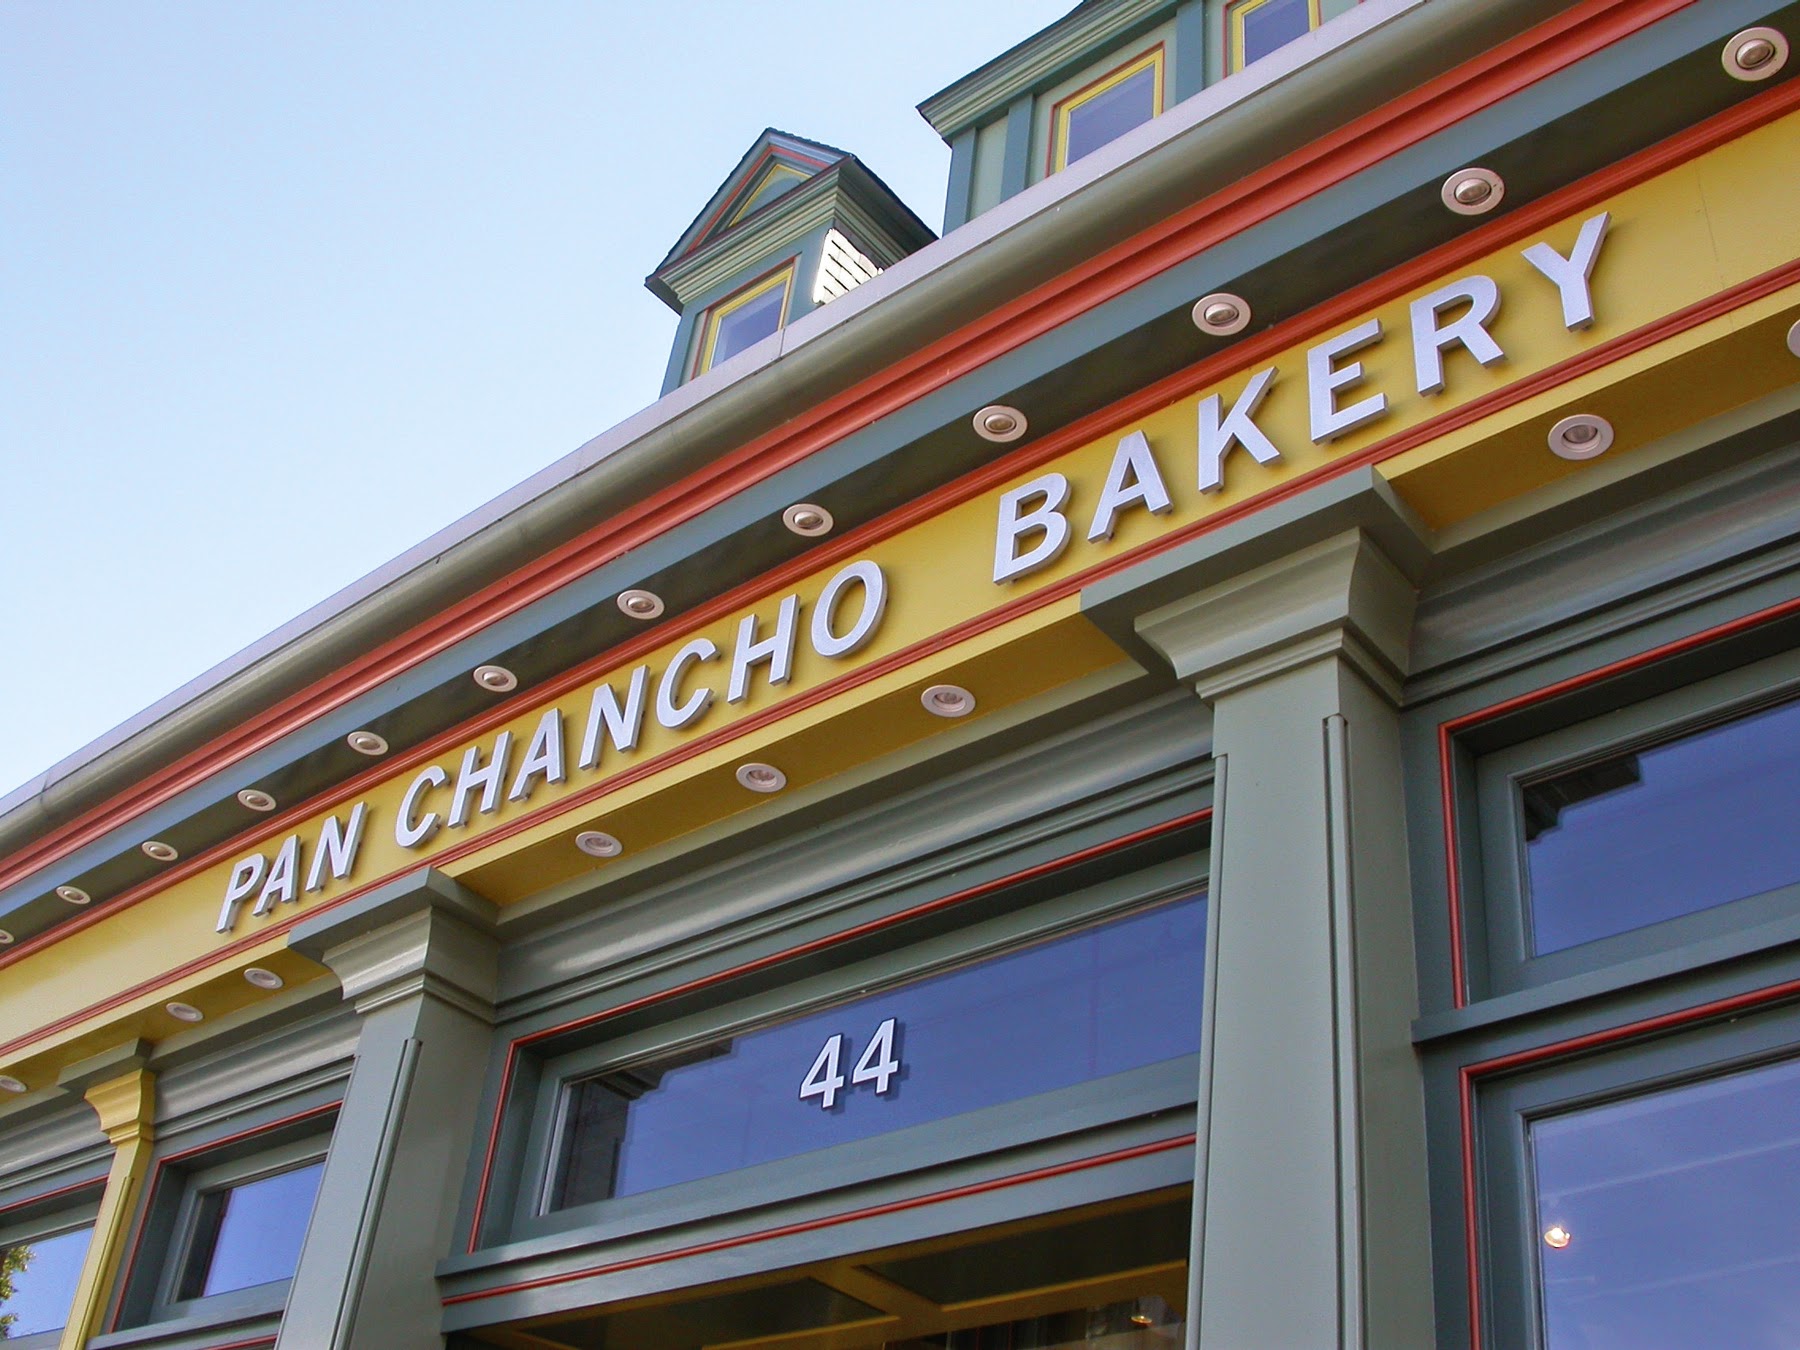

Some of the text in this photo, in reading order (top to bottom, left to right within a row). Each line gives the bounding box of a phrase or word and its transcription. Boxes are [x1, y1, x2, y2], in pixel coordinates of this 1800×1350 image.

[216, 212, 1611, 931] PAN CHANCHO BAKERY
[799, 1018, 900, 1108] 44
